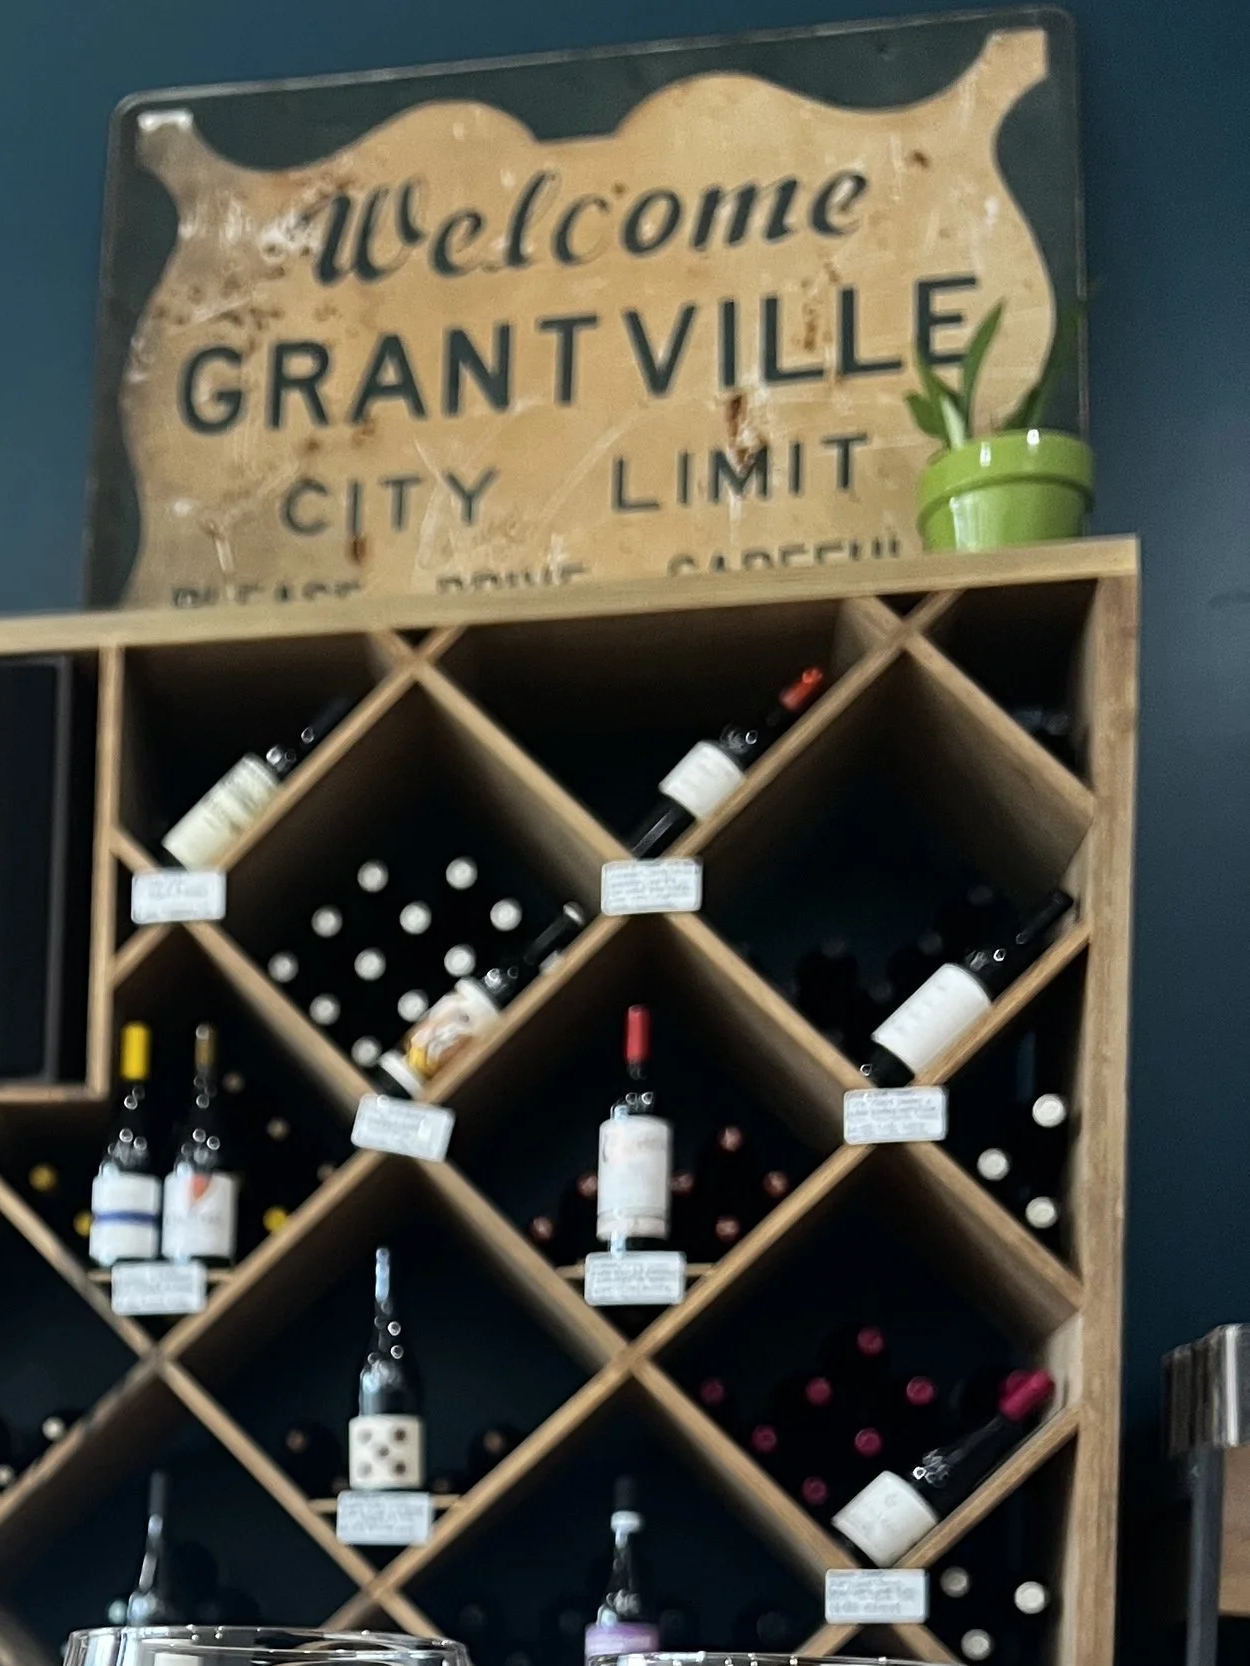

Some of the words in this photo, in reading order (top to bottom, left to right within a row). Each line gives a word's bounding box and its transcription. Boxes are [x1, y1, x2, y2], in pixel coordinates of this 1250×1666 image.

[298, 166, 868, 286] Welcome
[178, 273, 980, 437] GRANTVILLE
[280, 468, 502, 537] CITY
[610, 432, 869, 515] LIMIT
